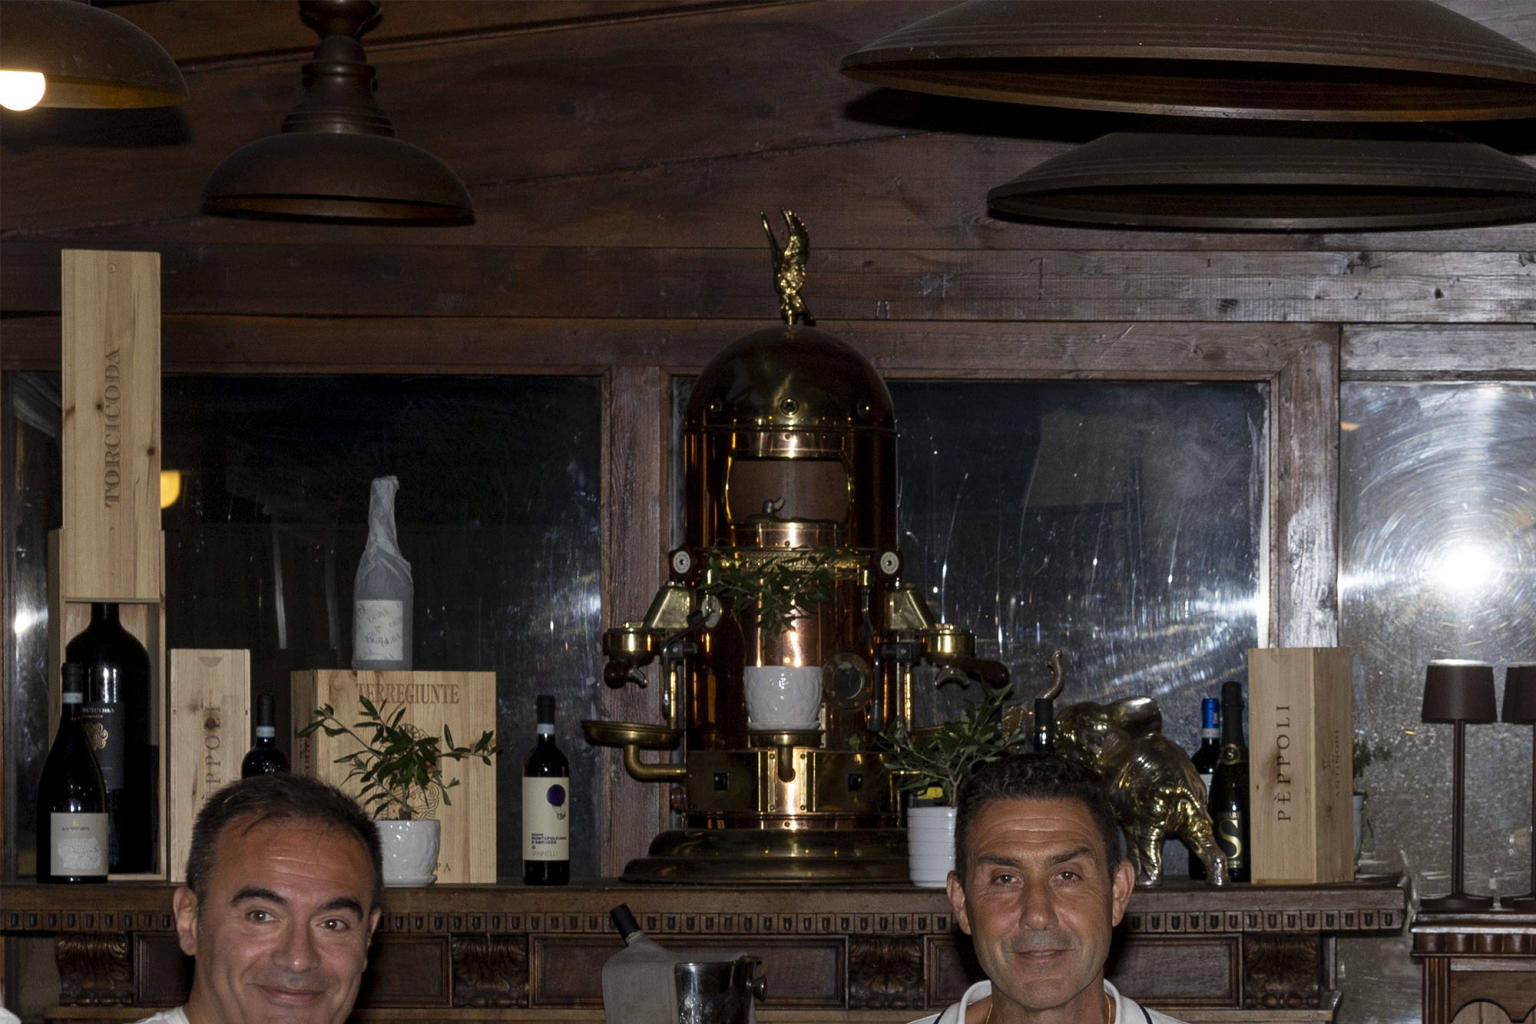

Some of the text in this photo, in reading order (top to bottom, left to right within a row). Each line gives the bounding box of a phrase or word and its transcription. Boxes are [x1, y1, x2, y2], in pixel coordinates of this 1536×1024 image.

[104, 346, 121, 509] TORCICODA
[356, 683, 460, 704] TERREGIUNTE
[201, 703, 221, 803] PPOLI
[1273, 704, 1292, 823] PÈPPOLI
